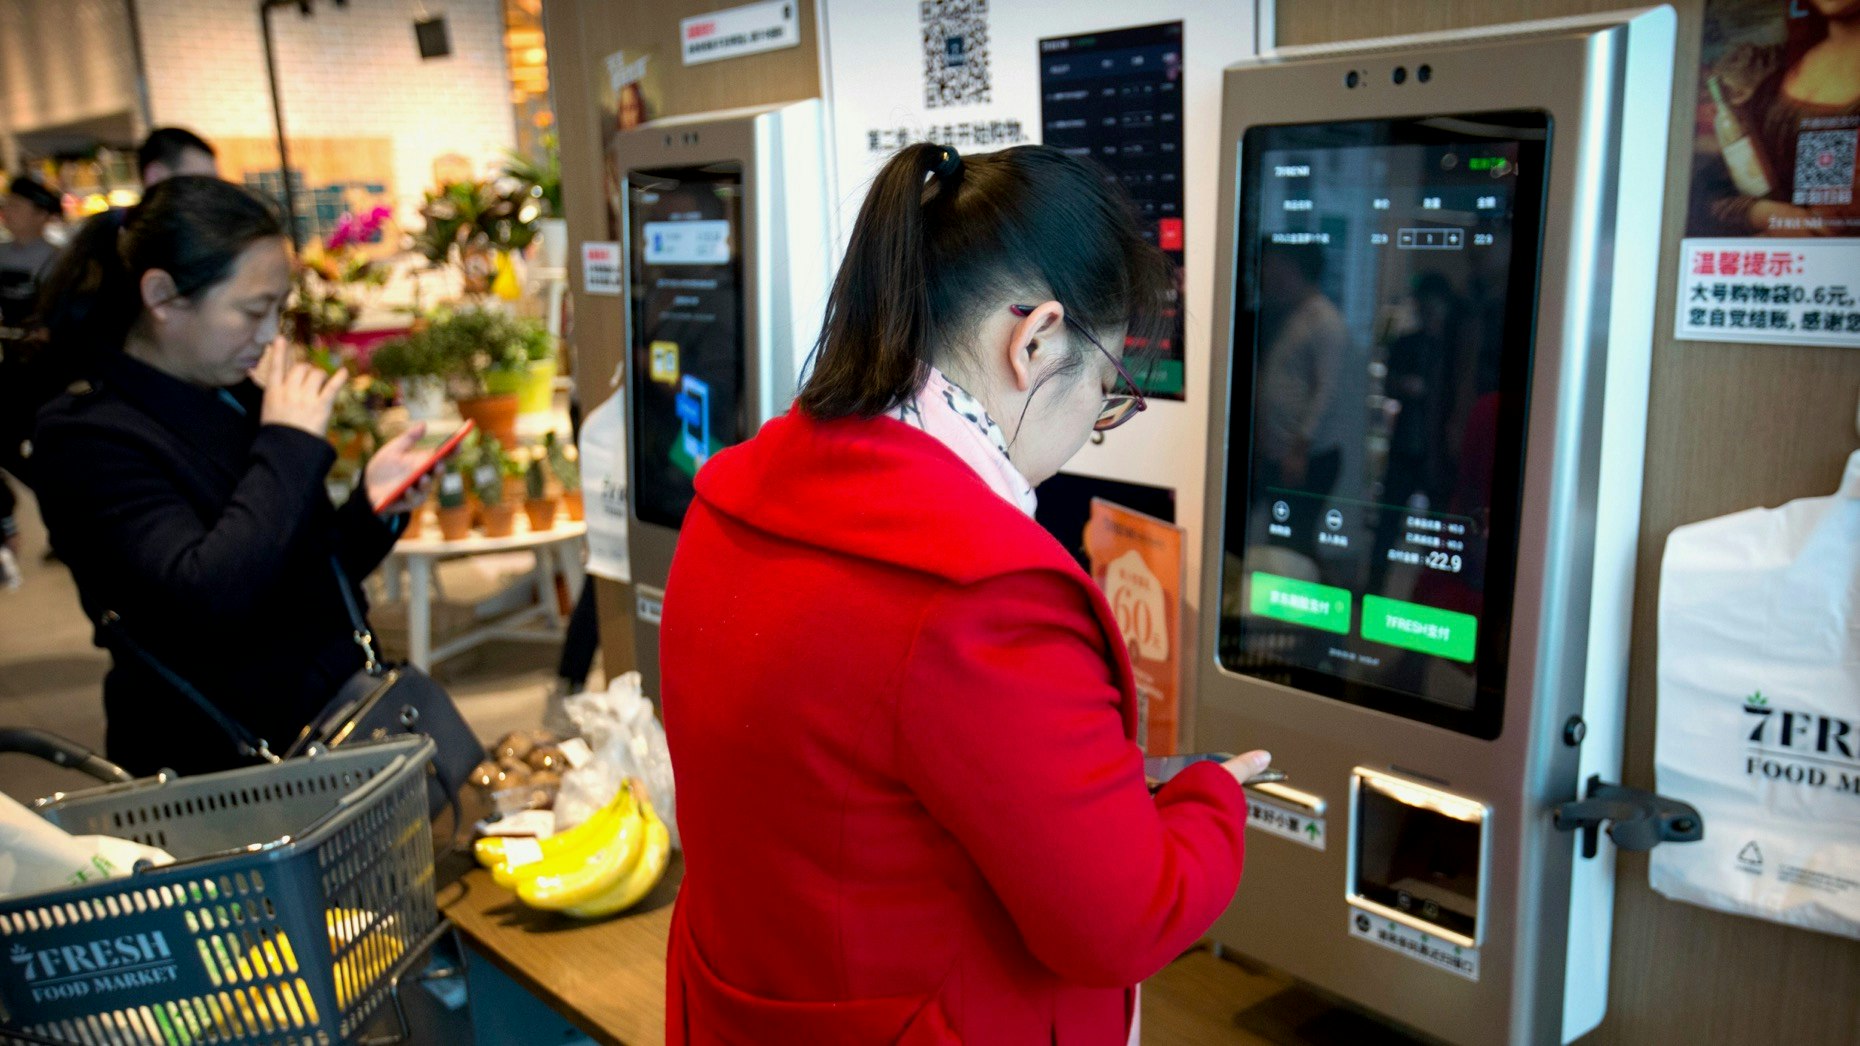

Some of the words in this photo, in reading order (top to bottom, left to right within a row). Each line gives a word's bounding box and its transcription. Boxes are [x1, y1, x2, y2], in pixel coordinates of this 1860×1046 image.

[1743, 703, 1860, 758] 7FR
[1747, 757, 1827, 787] FOOD
[9, 930, 172, 981] 7FRESH
[31, 980, 90, 1003] FOOD
[93, 964, 178, 992] MARKET
